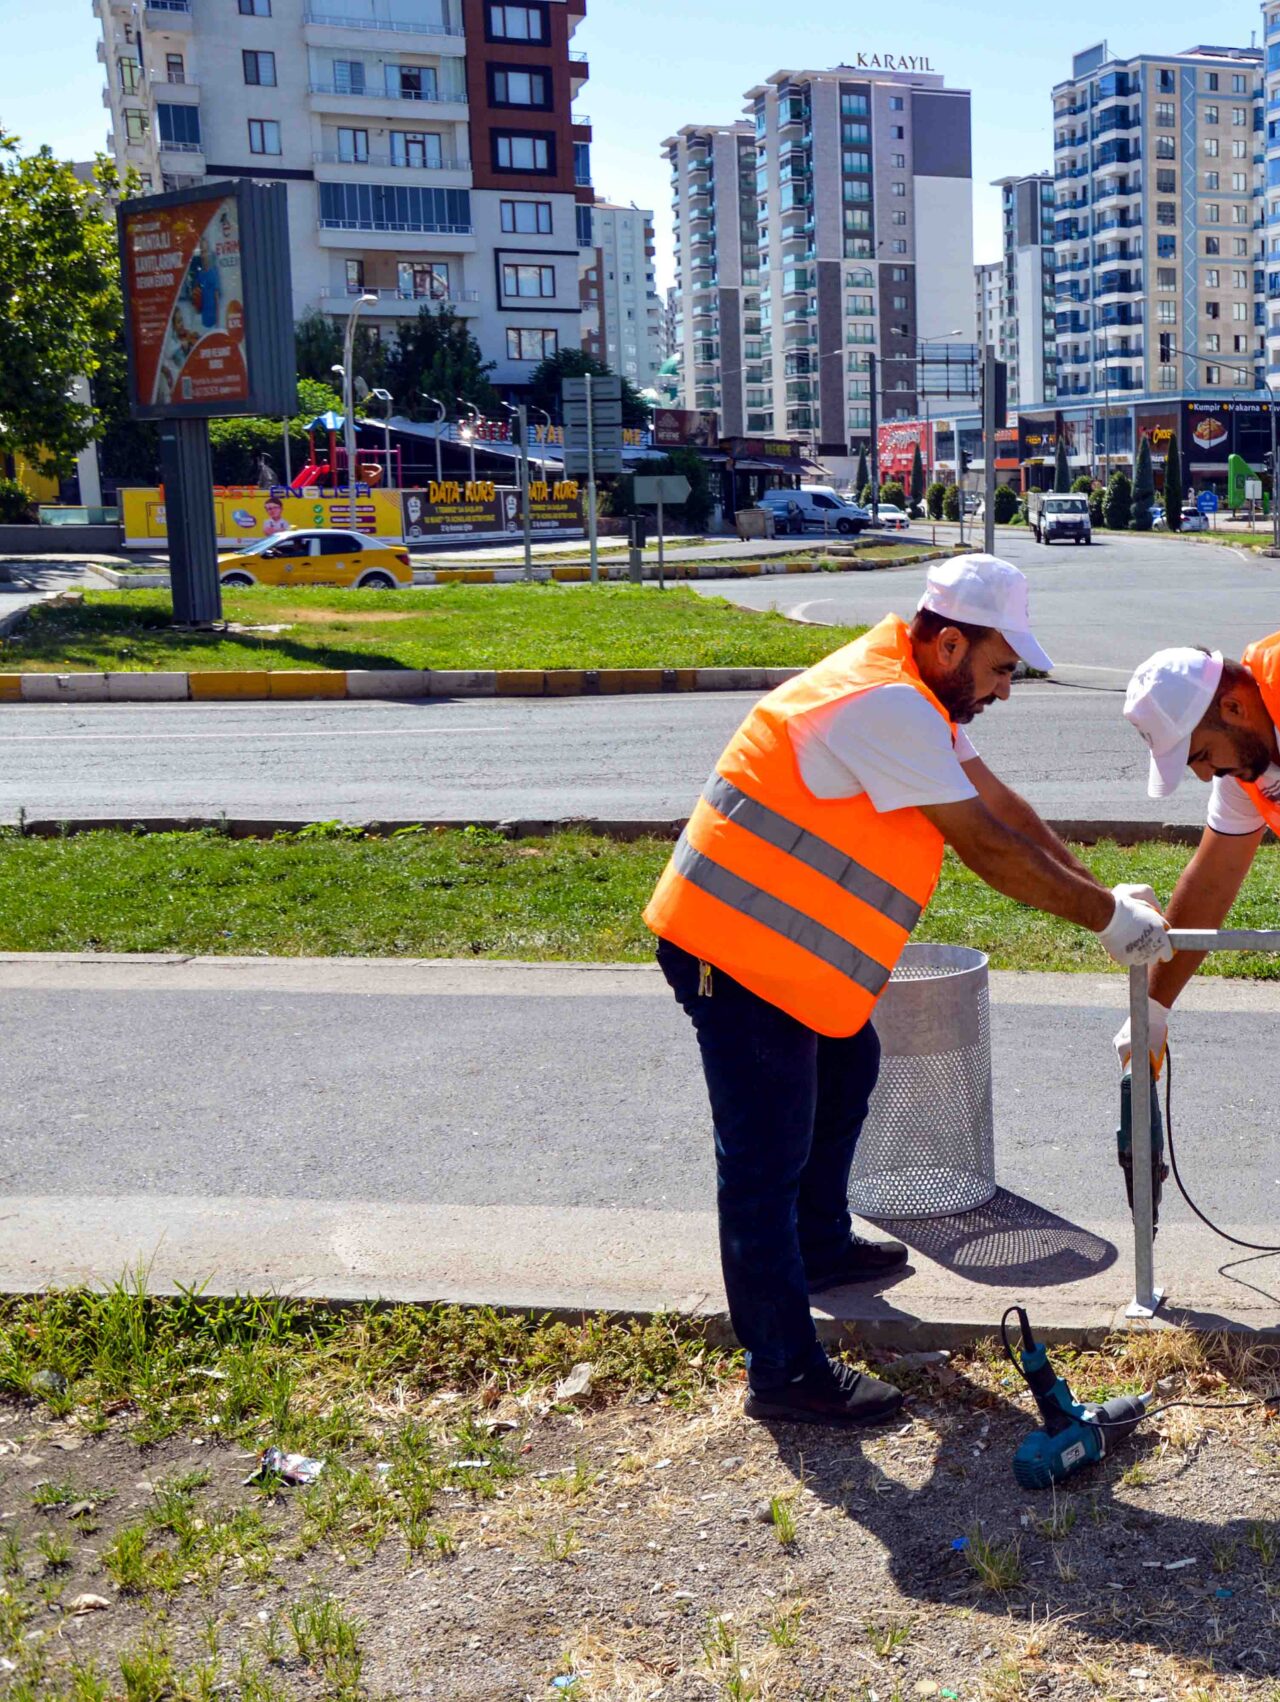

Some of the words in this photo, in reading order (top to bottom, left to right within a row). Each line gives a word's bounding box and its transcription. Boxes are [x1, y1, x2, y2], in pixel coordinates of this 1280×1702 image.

[857, 52, 935, 72] KARAYIL
[1194, 403, 1220, 413] Kumpir
[429, 481, 460, 504] DATA
[465, 480, 497, 502] KURS
[528, 481, 548, 501] ATA
[553, 480, 579, 500] KURS
